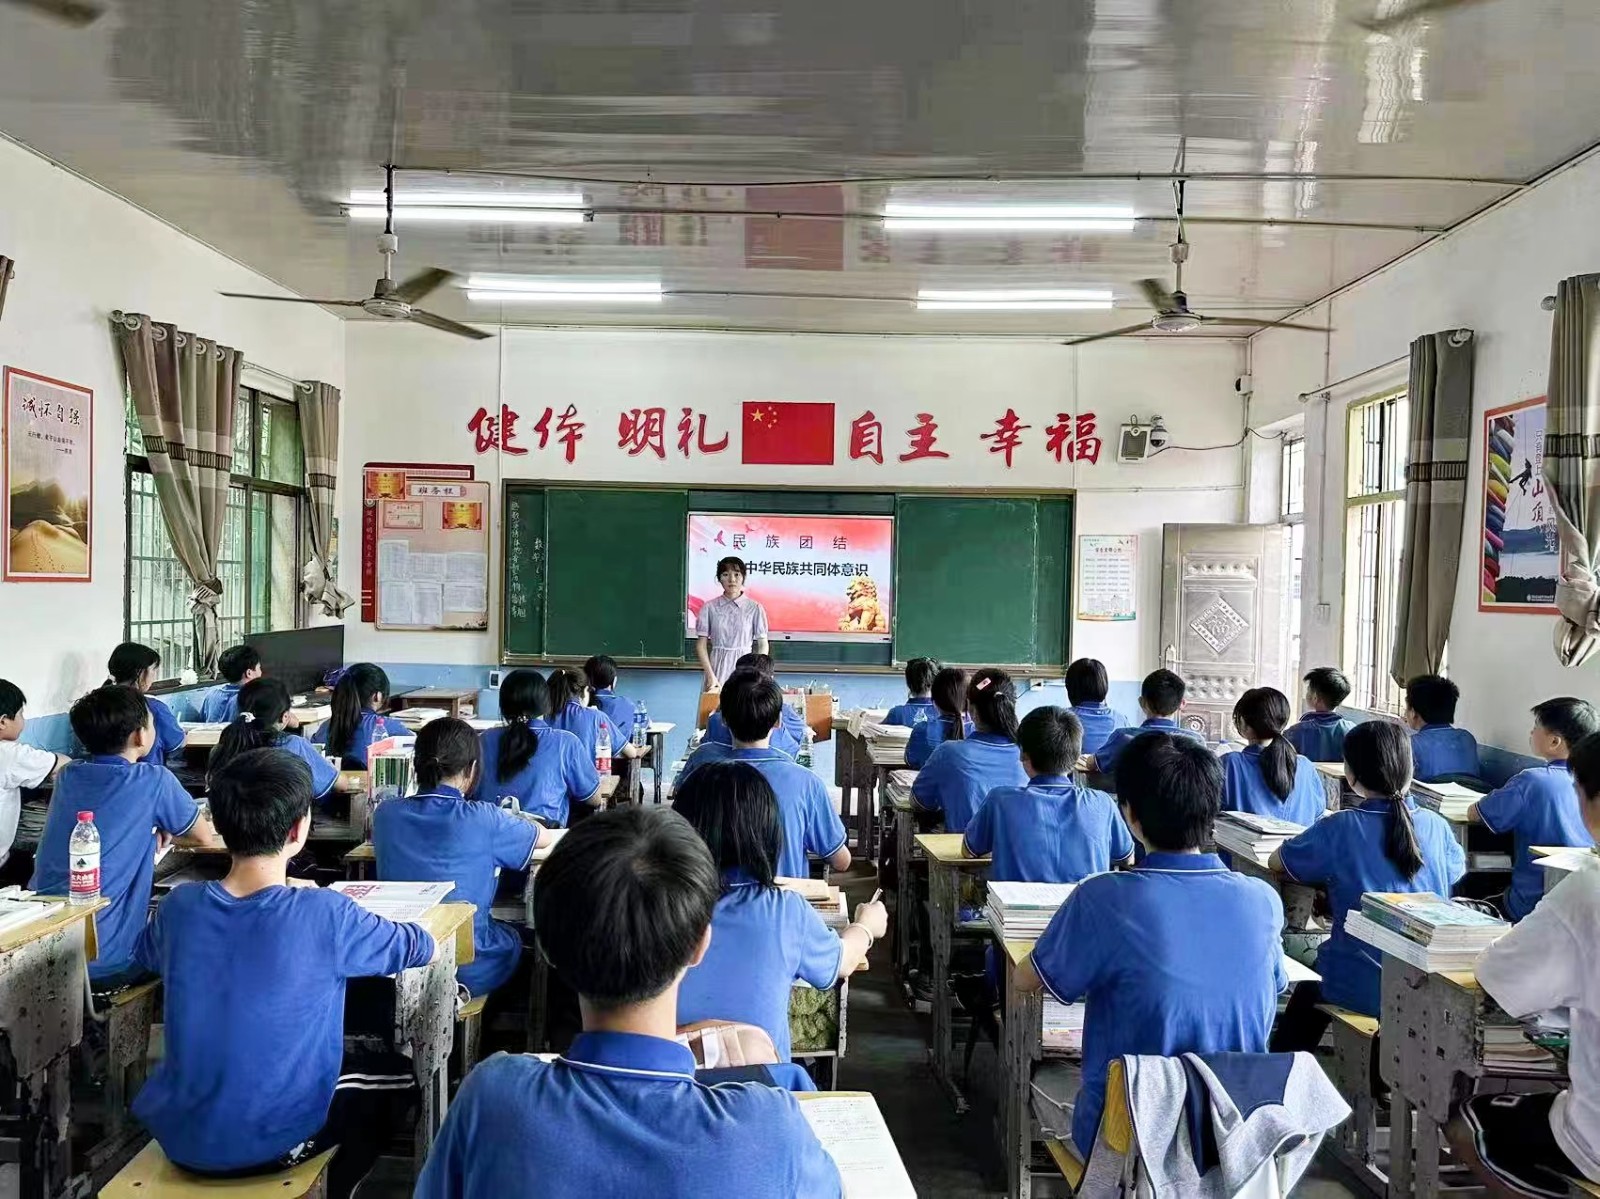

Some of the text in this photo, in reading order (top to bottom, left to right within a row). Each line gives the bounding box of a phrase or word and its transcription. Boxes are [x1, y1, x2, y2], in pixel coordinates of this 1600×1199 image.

[467, 403, 1103, 468] 健体 明礼 自主 幸福
[733, 534, 848, 550] 民族团结
[718, 561, 868, 577] 中华民族共同体意识
